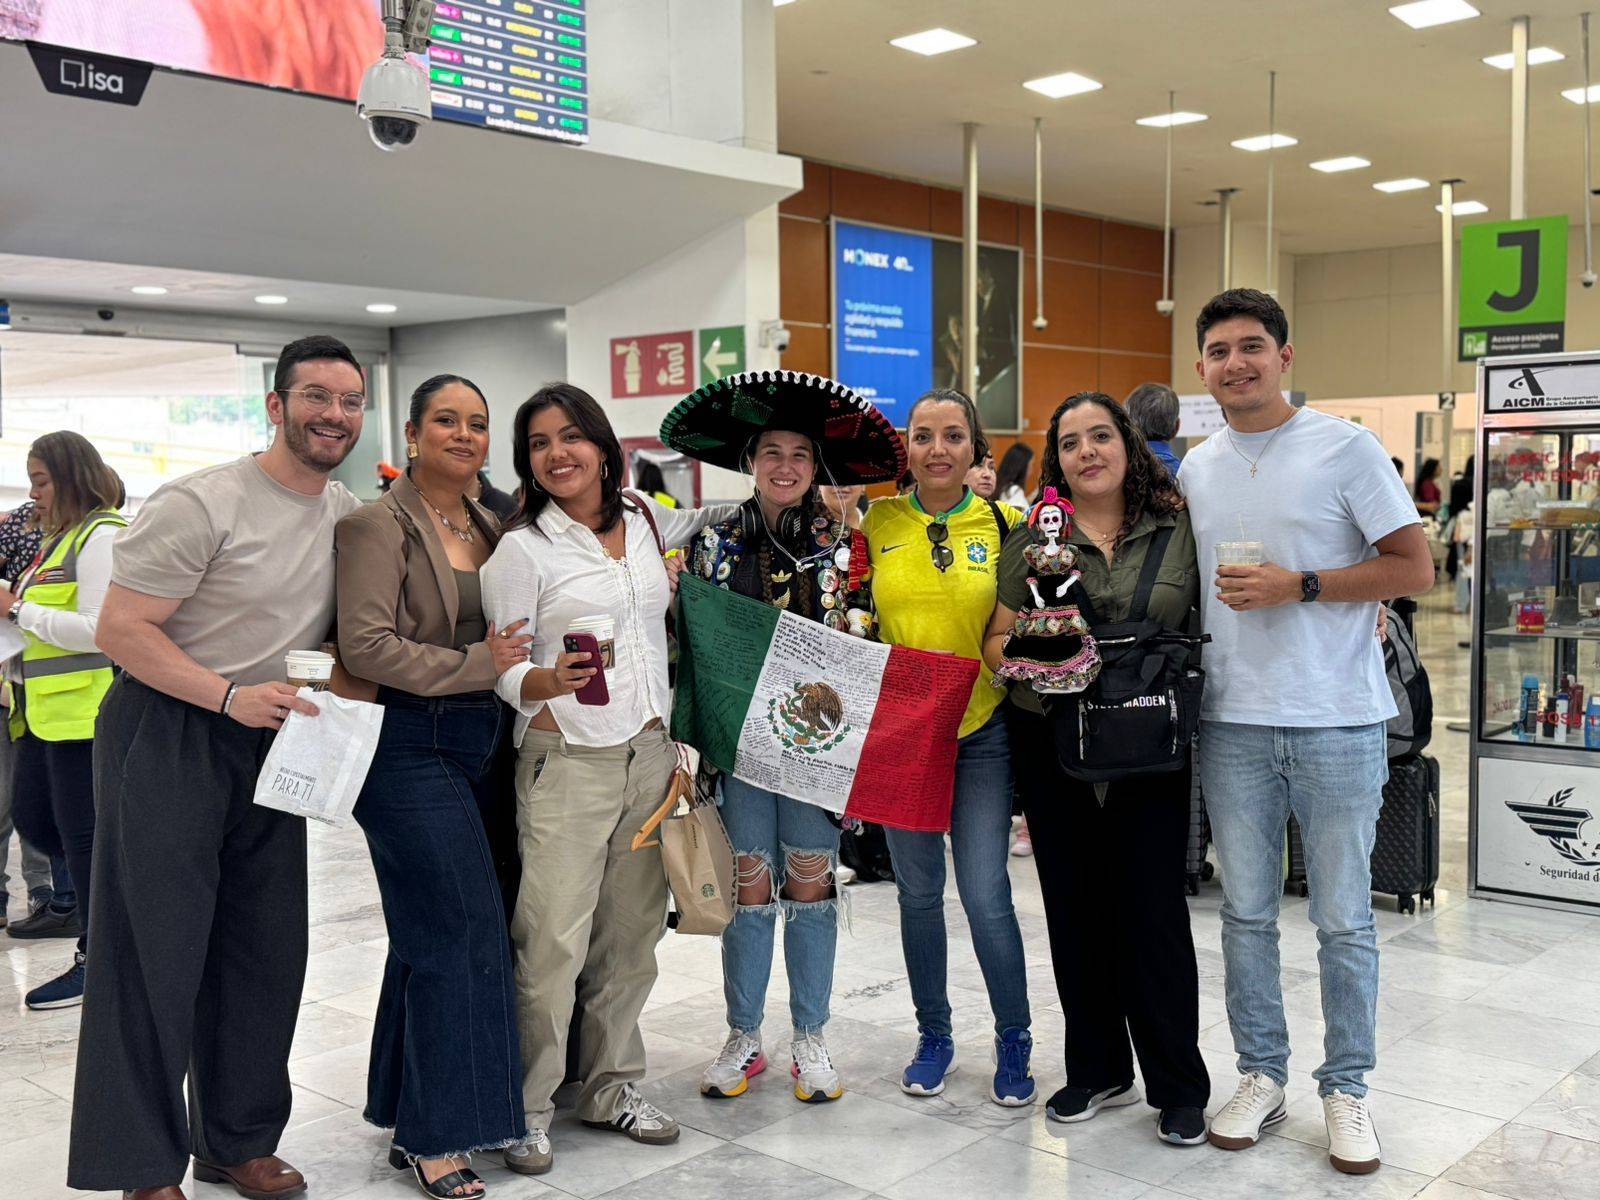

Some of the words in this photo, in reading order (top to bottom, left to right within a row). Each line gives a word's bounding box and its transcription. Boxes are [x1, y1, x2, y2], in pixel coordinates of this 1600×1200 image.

[87, 63, 124, 94] isa
[1486, 229, 1540, 312] J
[1491, 335, 1520, 343] Acceso
[1521, 333, 1560, 343] pasajeros
[1441, 392, 1454, 410] 2
[1503, 397, 1545, 408] AICM
[967, 565, 990, 574] BRASIL
[1122, 695, 1166, 708] MADDEN
[271, 773, 300, 797] PARA
[301, 783, 315, 801] TI
[1539, 864, 1590, 881] Seguridad
